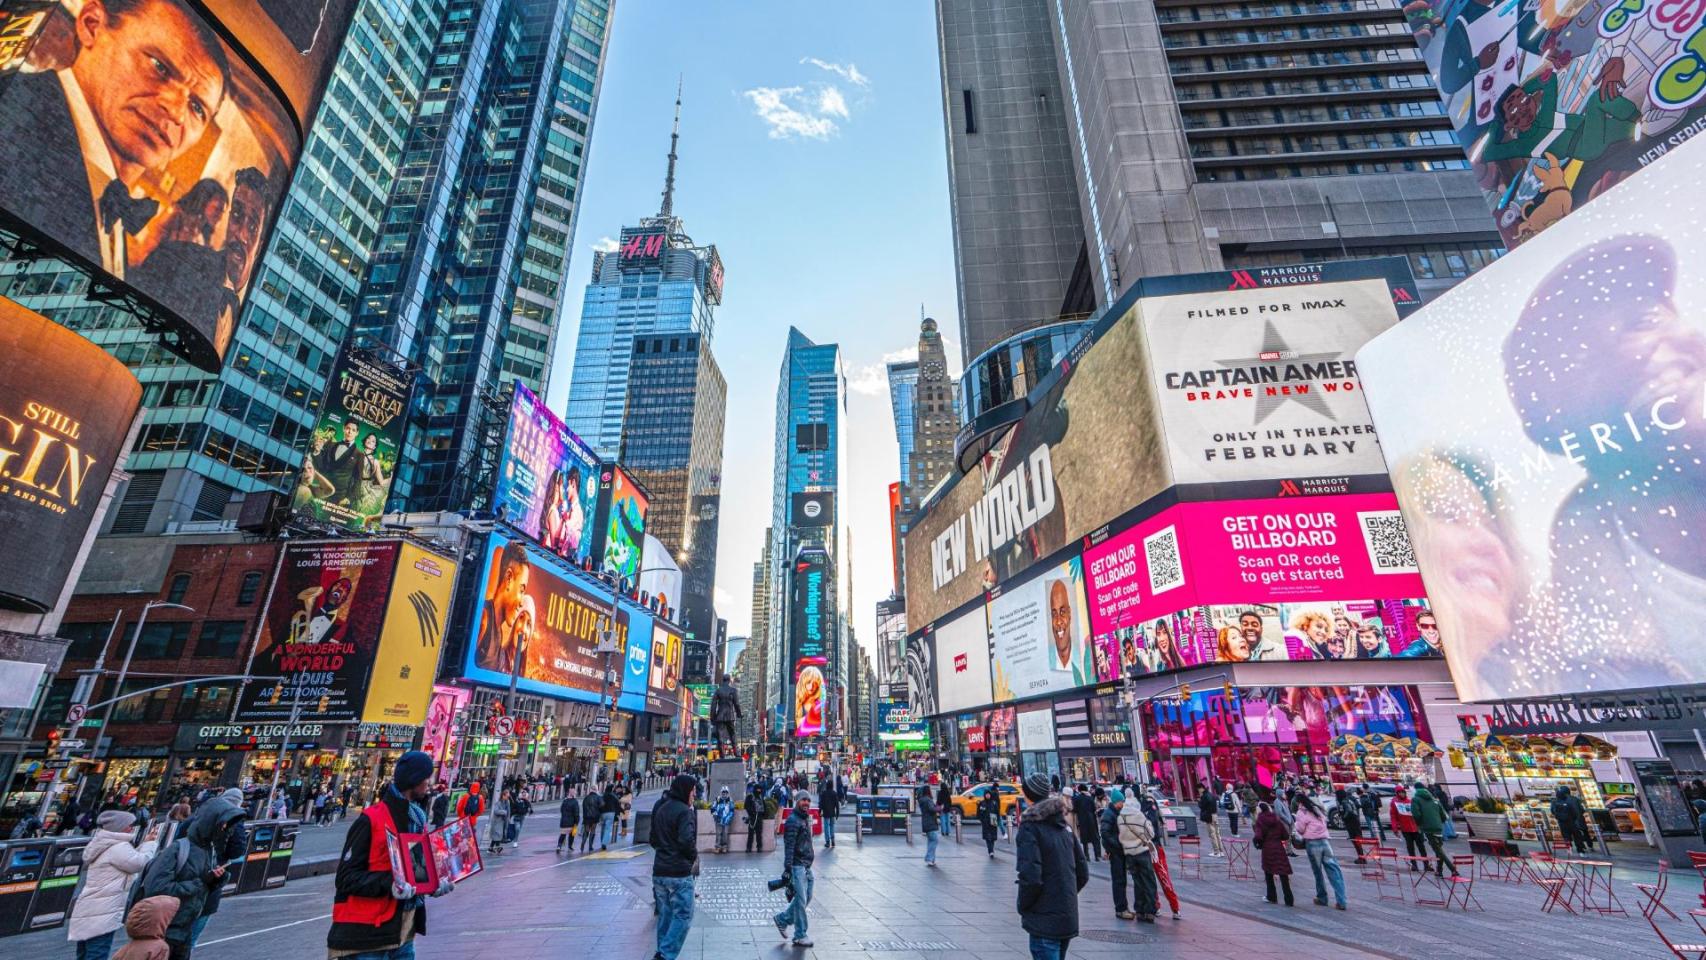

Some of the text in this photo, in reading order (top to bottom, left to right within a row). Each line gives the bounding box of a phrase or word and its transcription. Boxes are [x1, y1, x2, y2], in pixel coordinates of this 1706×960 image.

[1638, 142, 1667, 167] NEW
[621, 234, 665, 260] H&M
[1260, 265, 1324, 276] MARRIOTT
[1263, 274, 1320, 285] MARQUIS
[1187, 299, 1346, 319] FILMED FOR IMAX
[1166, 360, 1359, 390] CAPTAIN AMER
[341, 376, 405, 417] THE GREAT
[1187, 388, 1253, 401] BRAVE
[1266, 384, 1309, 396] NEW
[342, 394, 395, 426] GATSBY
[23, 401, 81, 440] STILL
[1212, 424, 1376, 443] ONLY IN THEATER
[1489, 381, 1706, 491] AMERIC
[1204, 440, 1358, 461] FEBRUARY
[1302, 477, 1350, 487] MARRIOTT
[1304, 485, 1347, 495] MARQUIS
[14, 489, 67, 515] AND SNOOP
[931, 443, 1056, 593] NEW WORLD
[1222, 512, 1338, 533] GET ON OUR
[1231, 530, 1337, 551] BILLBOARD
[296, 559, 321, 567] LOUIS
[322, 551, 368, 559] KNOCKOUT
[1090, 543, 1137, 576] GET ON OUR
[1238, 552, 1341, 568] Scan QR code
[1094, 560, 1137, 590] BILLBOARD
[1240, 566, 1345, 585] to get started
[803, 571, 821, 615] Working
[1097, 580, 1139, 605] Scan QR code
[1099, 594, 1141, 617] to get started
[805, 615, 821, 640] late?
[275, 642, 356, 656] A WONDERFUL
[629, 643, 647, 663] prime
[279, 655, 345, 672] WORLD
[291, 672, 335, 686] LOUIS
[1029, 679, 1049, 689] SEPHORA
[259, 686, 329, 698] ARSTRONG
[1096, 687, 1114, 695] SEPHORA
[199, 726, 243, 737] GIFTS
[1092, 732, 1126, 745] SEPHORA
